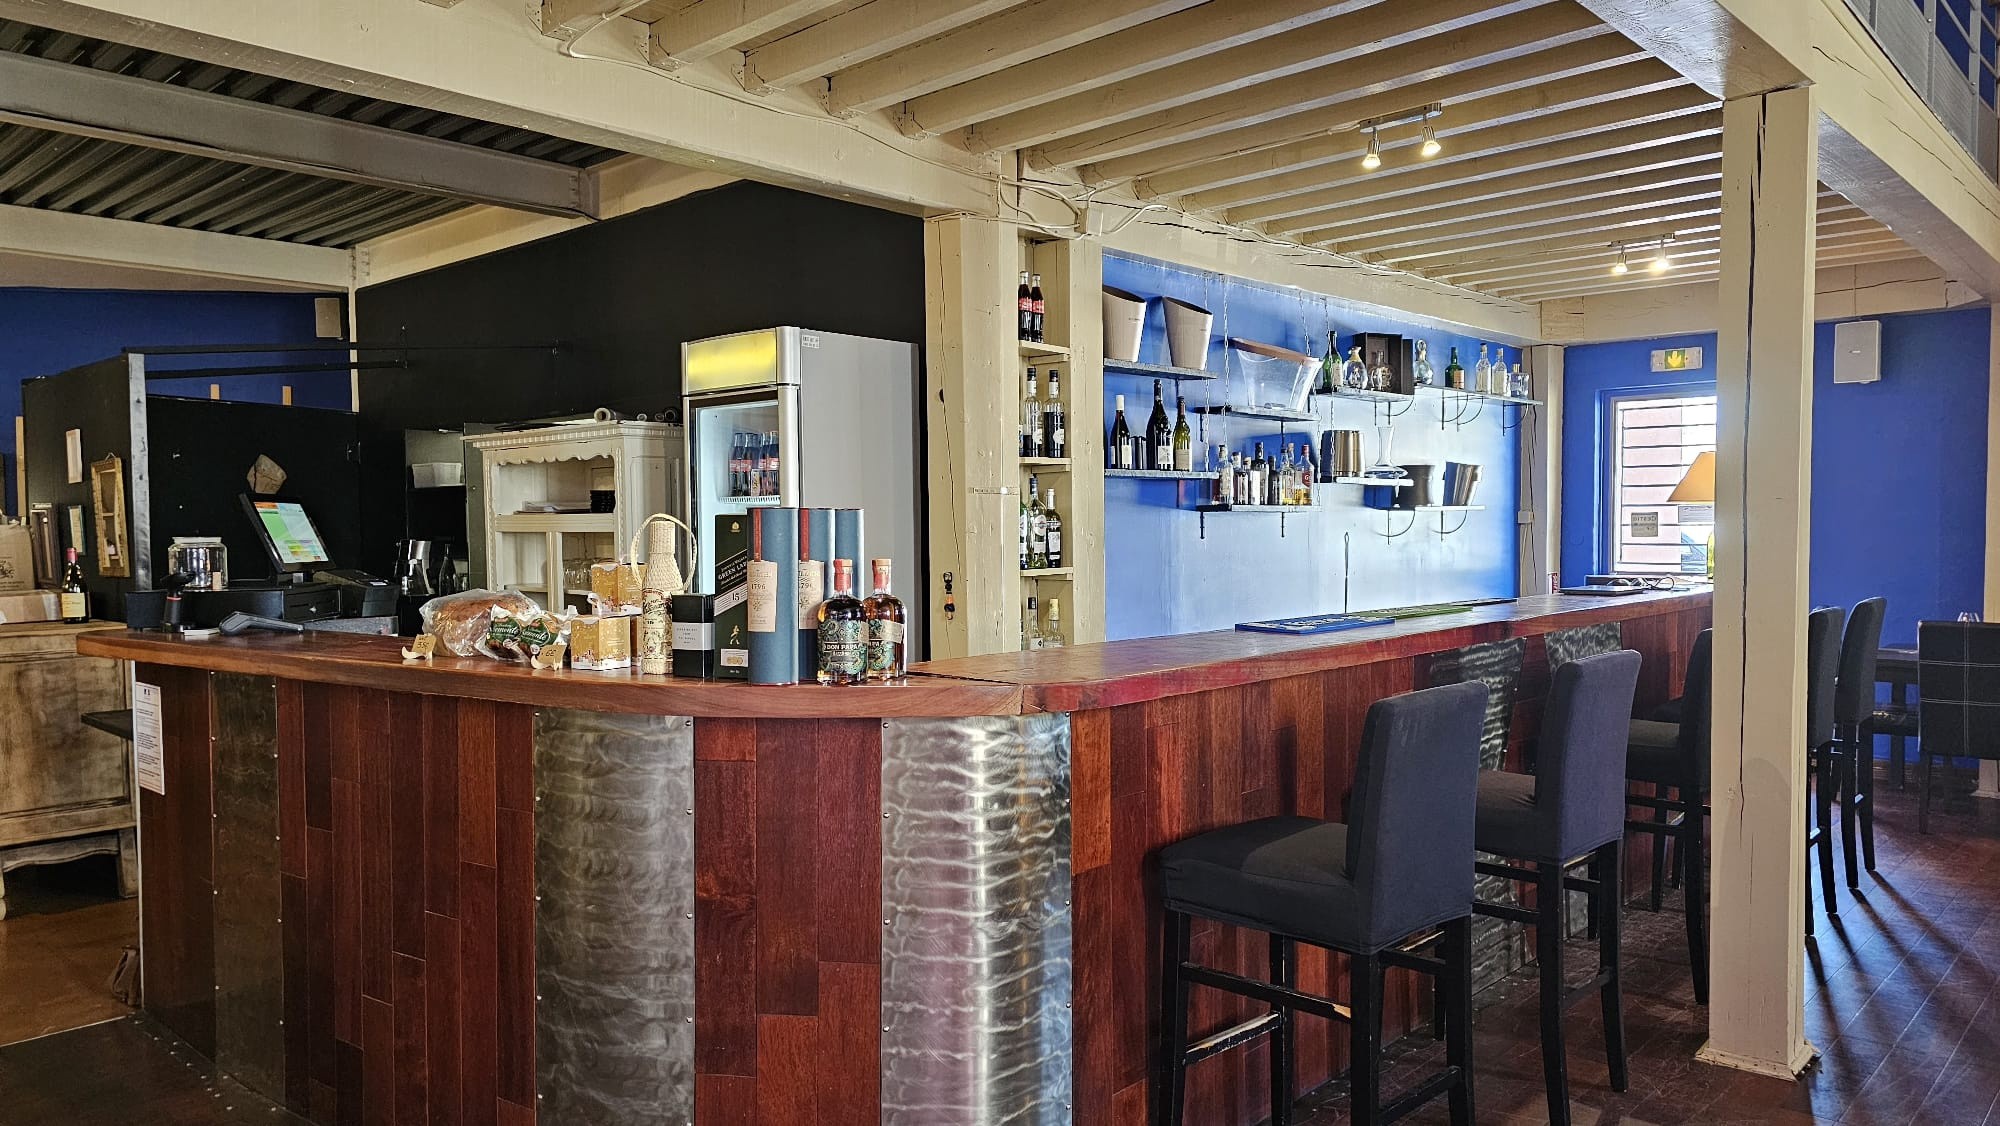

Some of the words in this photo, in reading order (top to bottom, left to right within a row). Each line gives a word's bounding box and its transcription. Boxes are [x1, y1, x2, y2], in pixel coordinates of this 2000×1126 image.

[718, 567, 736, 580] GREEN
[732, 592, 740, 601] 15
[840, 643, 859, 651] PAPA
